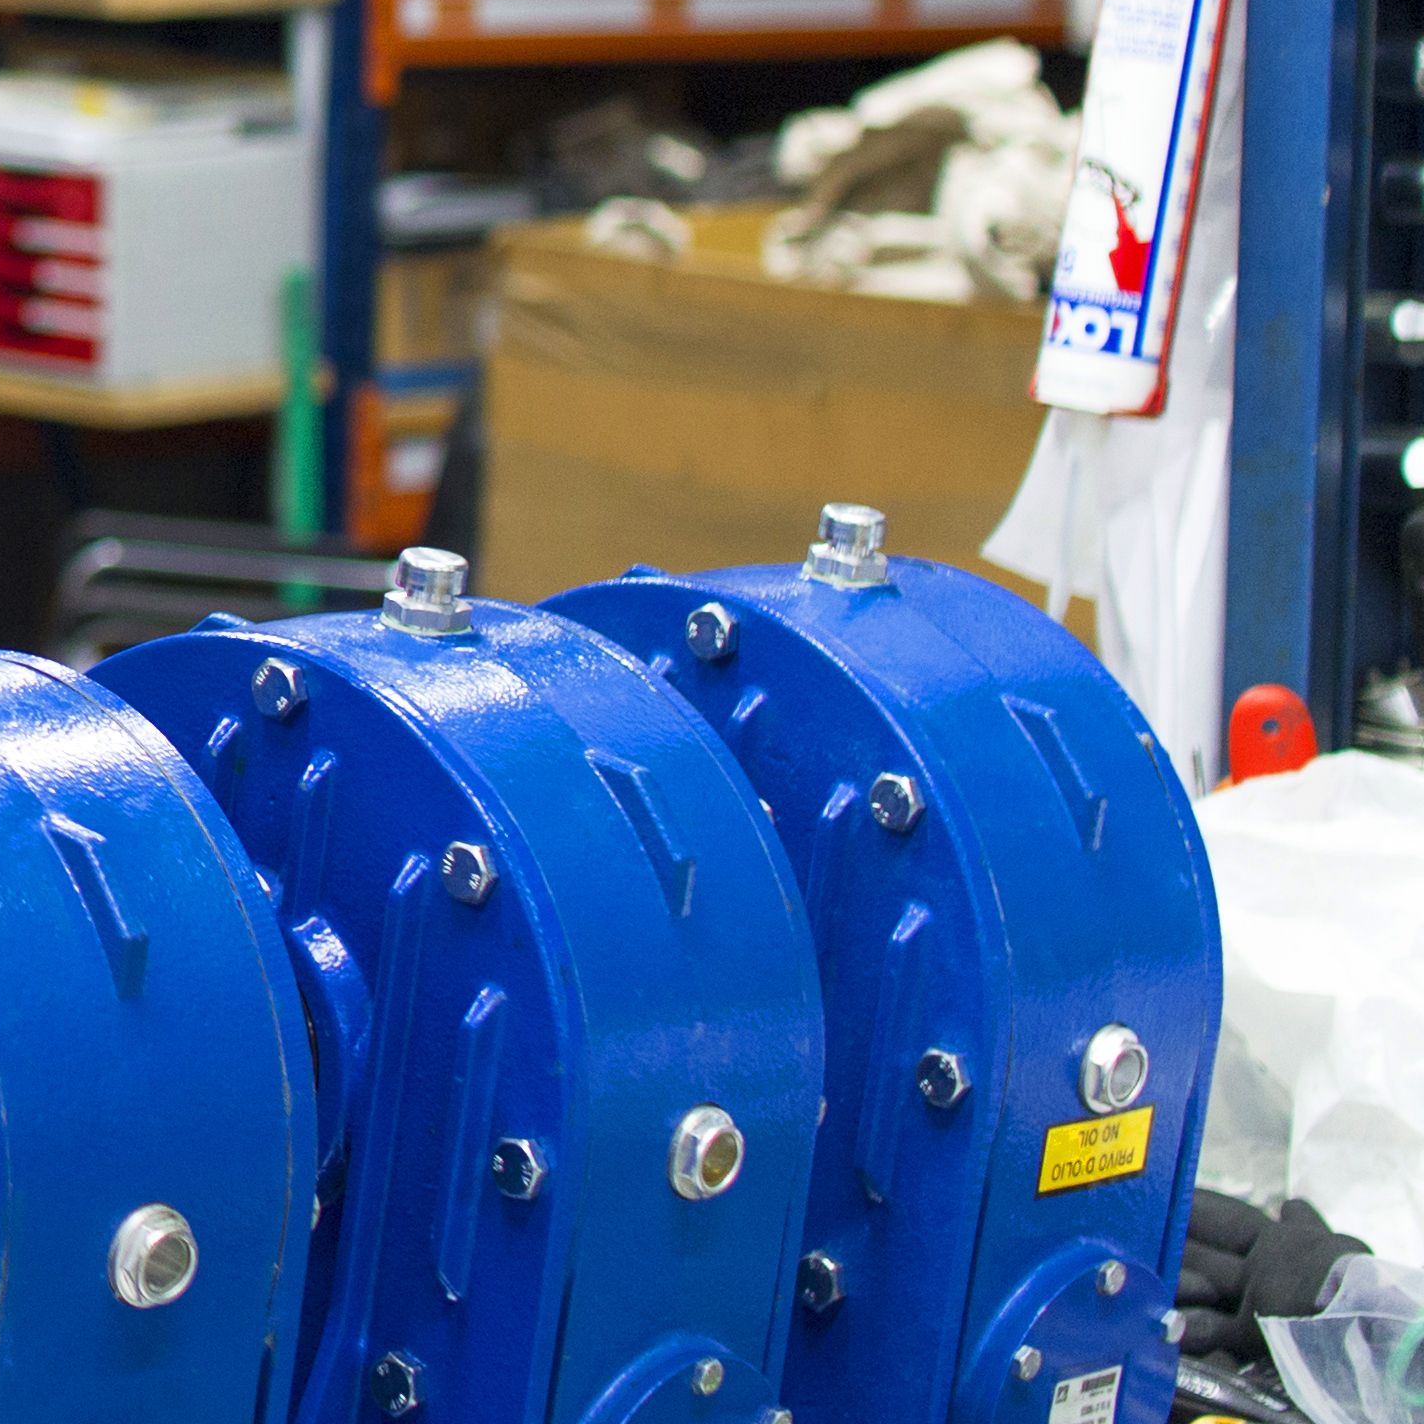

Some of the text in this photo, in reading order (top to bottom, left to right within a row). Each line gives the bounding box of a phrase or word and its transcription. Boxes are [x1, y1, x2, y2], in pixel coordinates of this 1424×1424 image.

[1078, 1122, 1121, 1148] NO OIL
[1098, 1147, 1135, 1171] PRIVO
